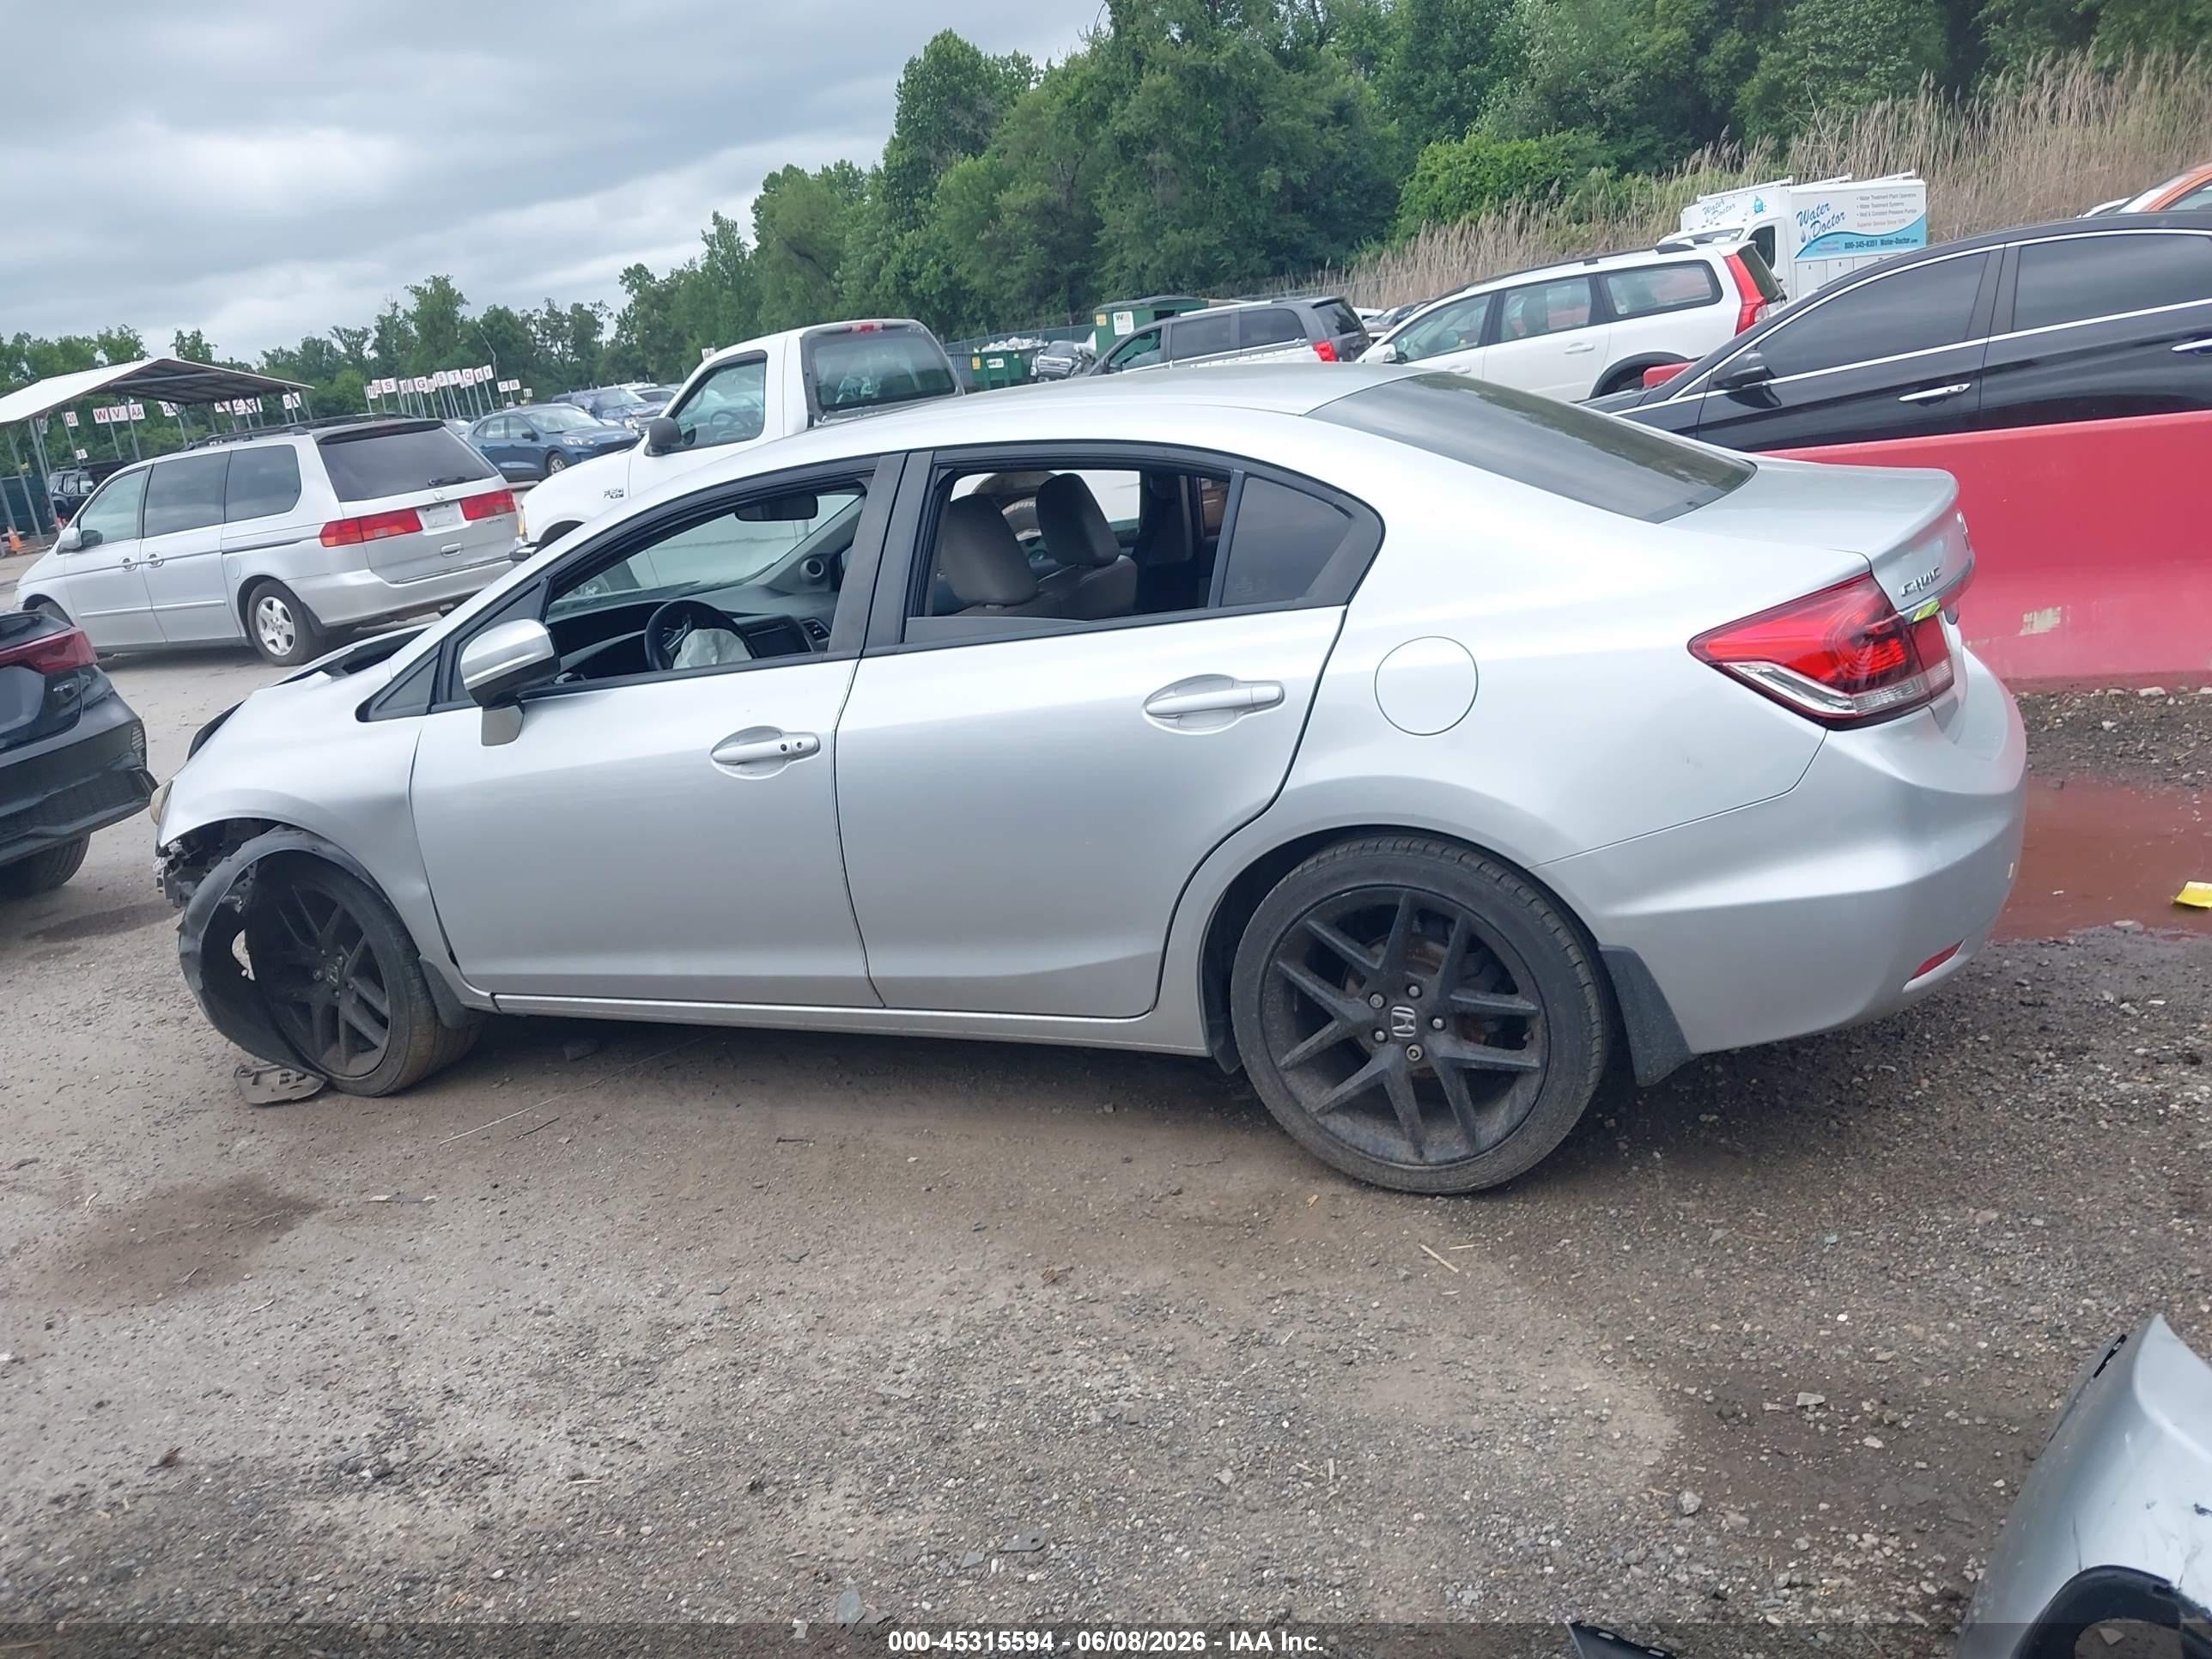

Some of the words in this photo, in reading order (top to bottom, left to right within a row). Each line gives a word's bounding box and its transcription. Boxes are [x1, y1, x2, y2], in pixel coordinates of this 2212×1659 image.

[1796, 200, 1830, 227] Water
[1809, 210, 1847, 238] Doctor
[417, 379, 426, 389] G
